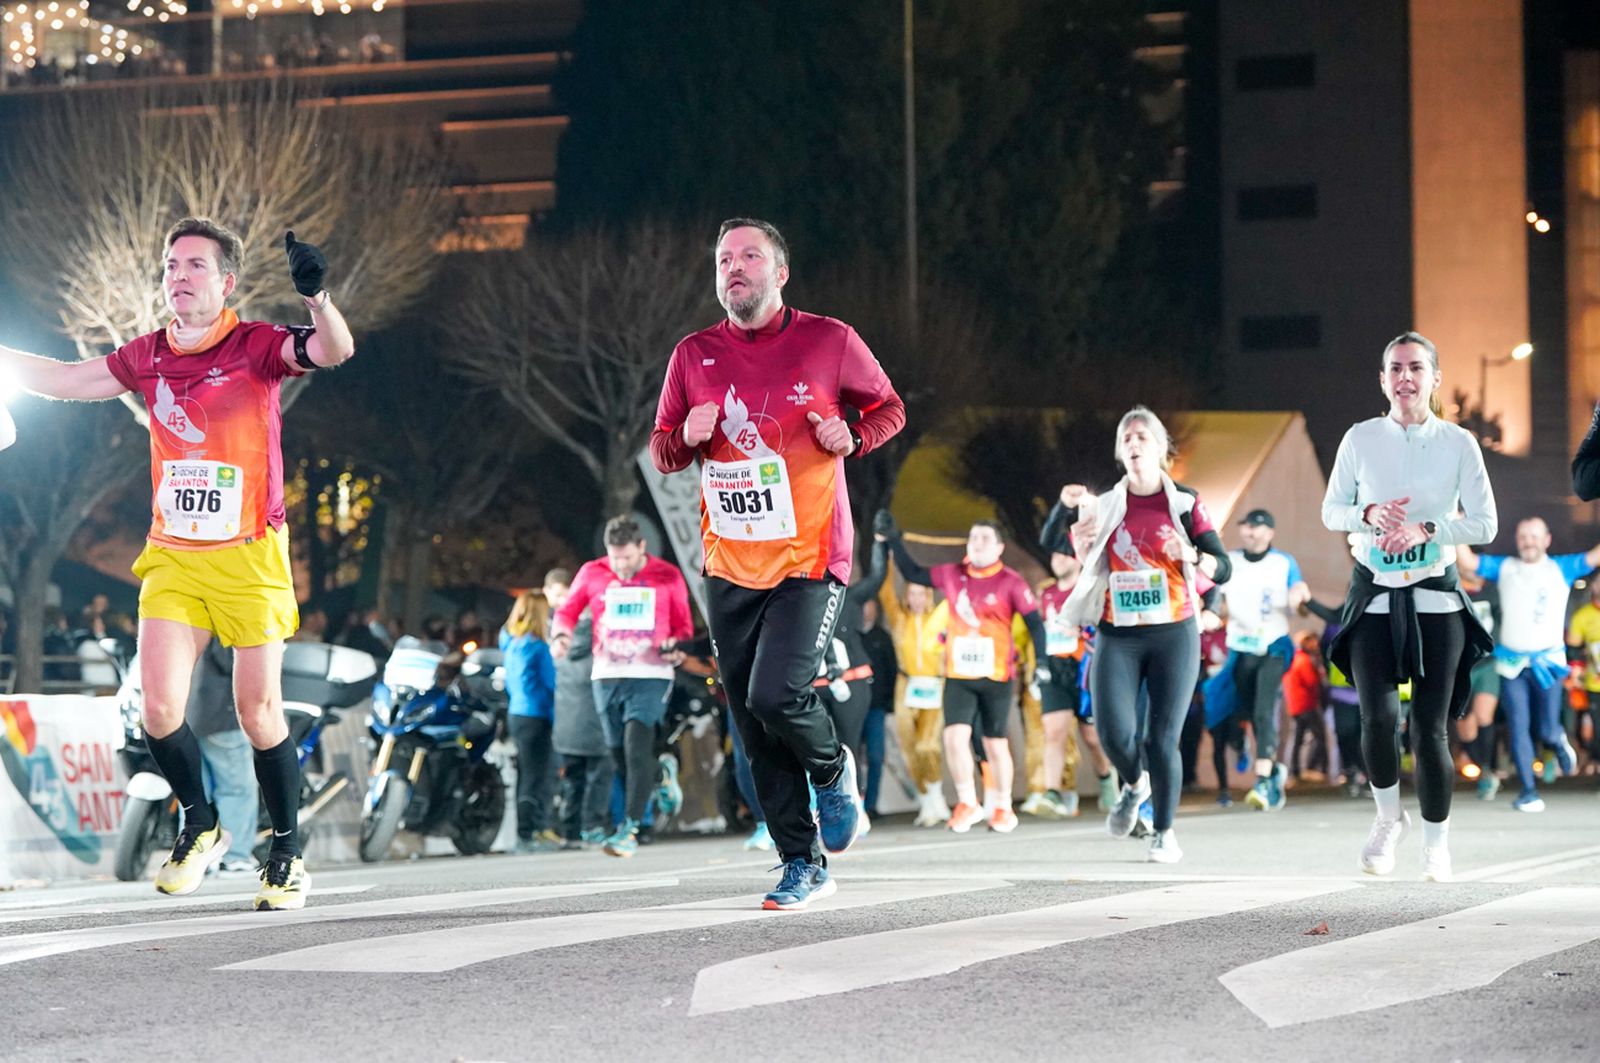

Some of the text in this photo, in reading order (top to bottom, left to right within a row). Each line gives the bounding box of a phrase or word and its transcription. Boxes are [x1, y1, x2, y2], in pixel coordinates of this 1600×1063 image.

[168, 411, 187, 433] 43
[736, 428, 757, 450] 43
[199, 469, 209, 477] DE
[715, 471, 739, 480] NOCHE
[741, 469, 752, 478] DE
[709, 480, 724, 489] SAN
[175, 489, 221, 512] 7676
[718, 488, 774, 515] 5031
[1119, 590, 1162, 607] 12468
[62, 744, 113, 784] SAN
[30, 762, 67, 831] 43
[79, 791, 127, 831] ANT
